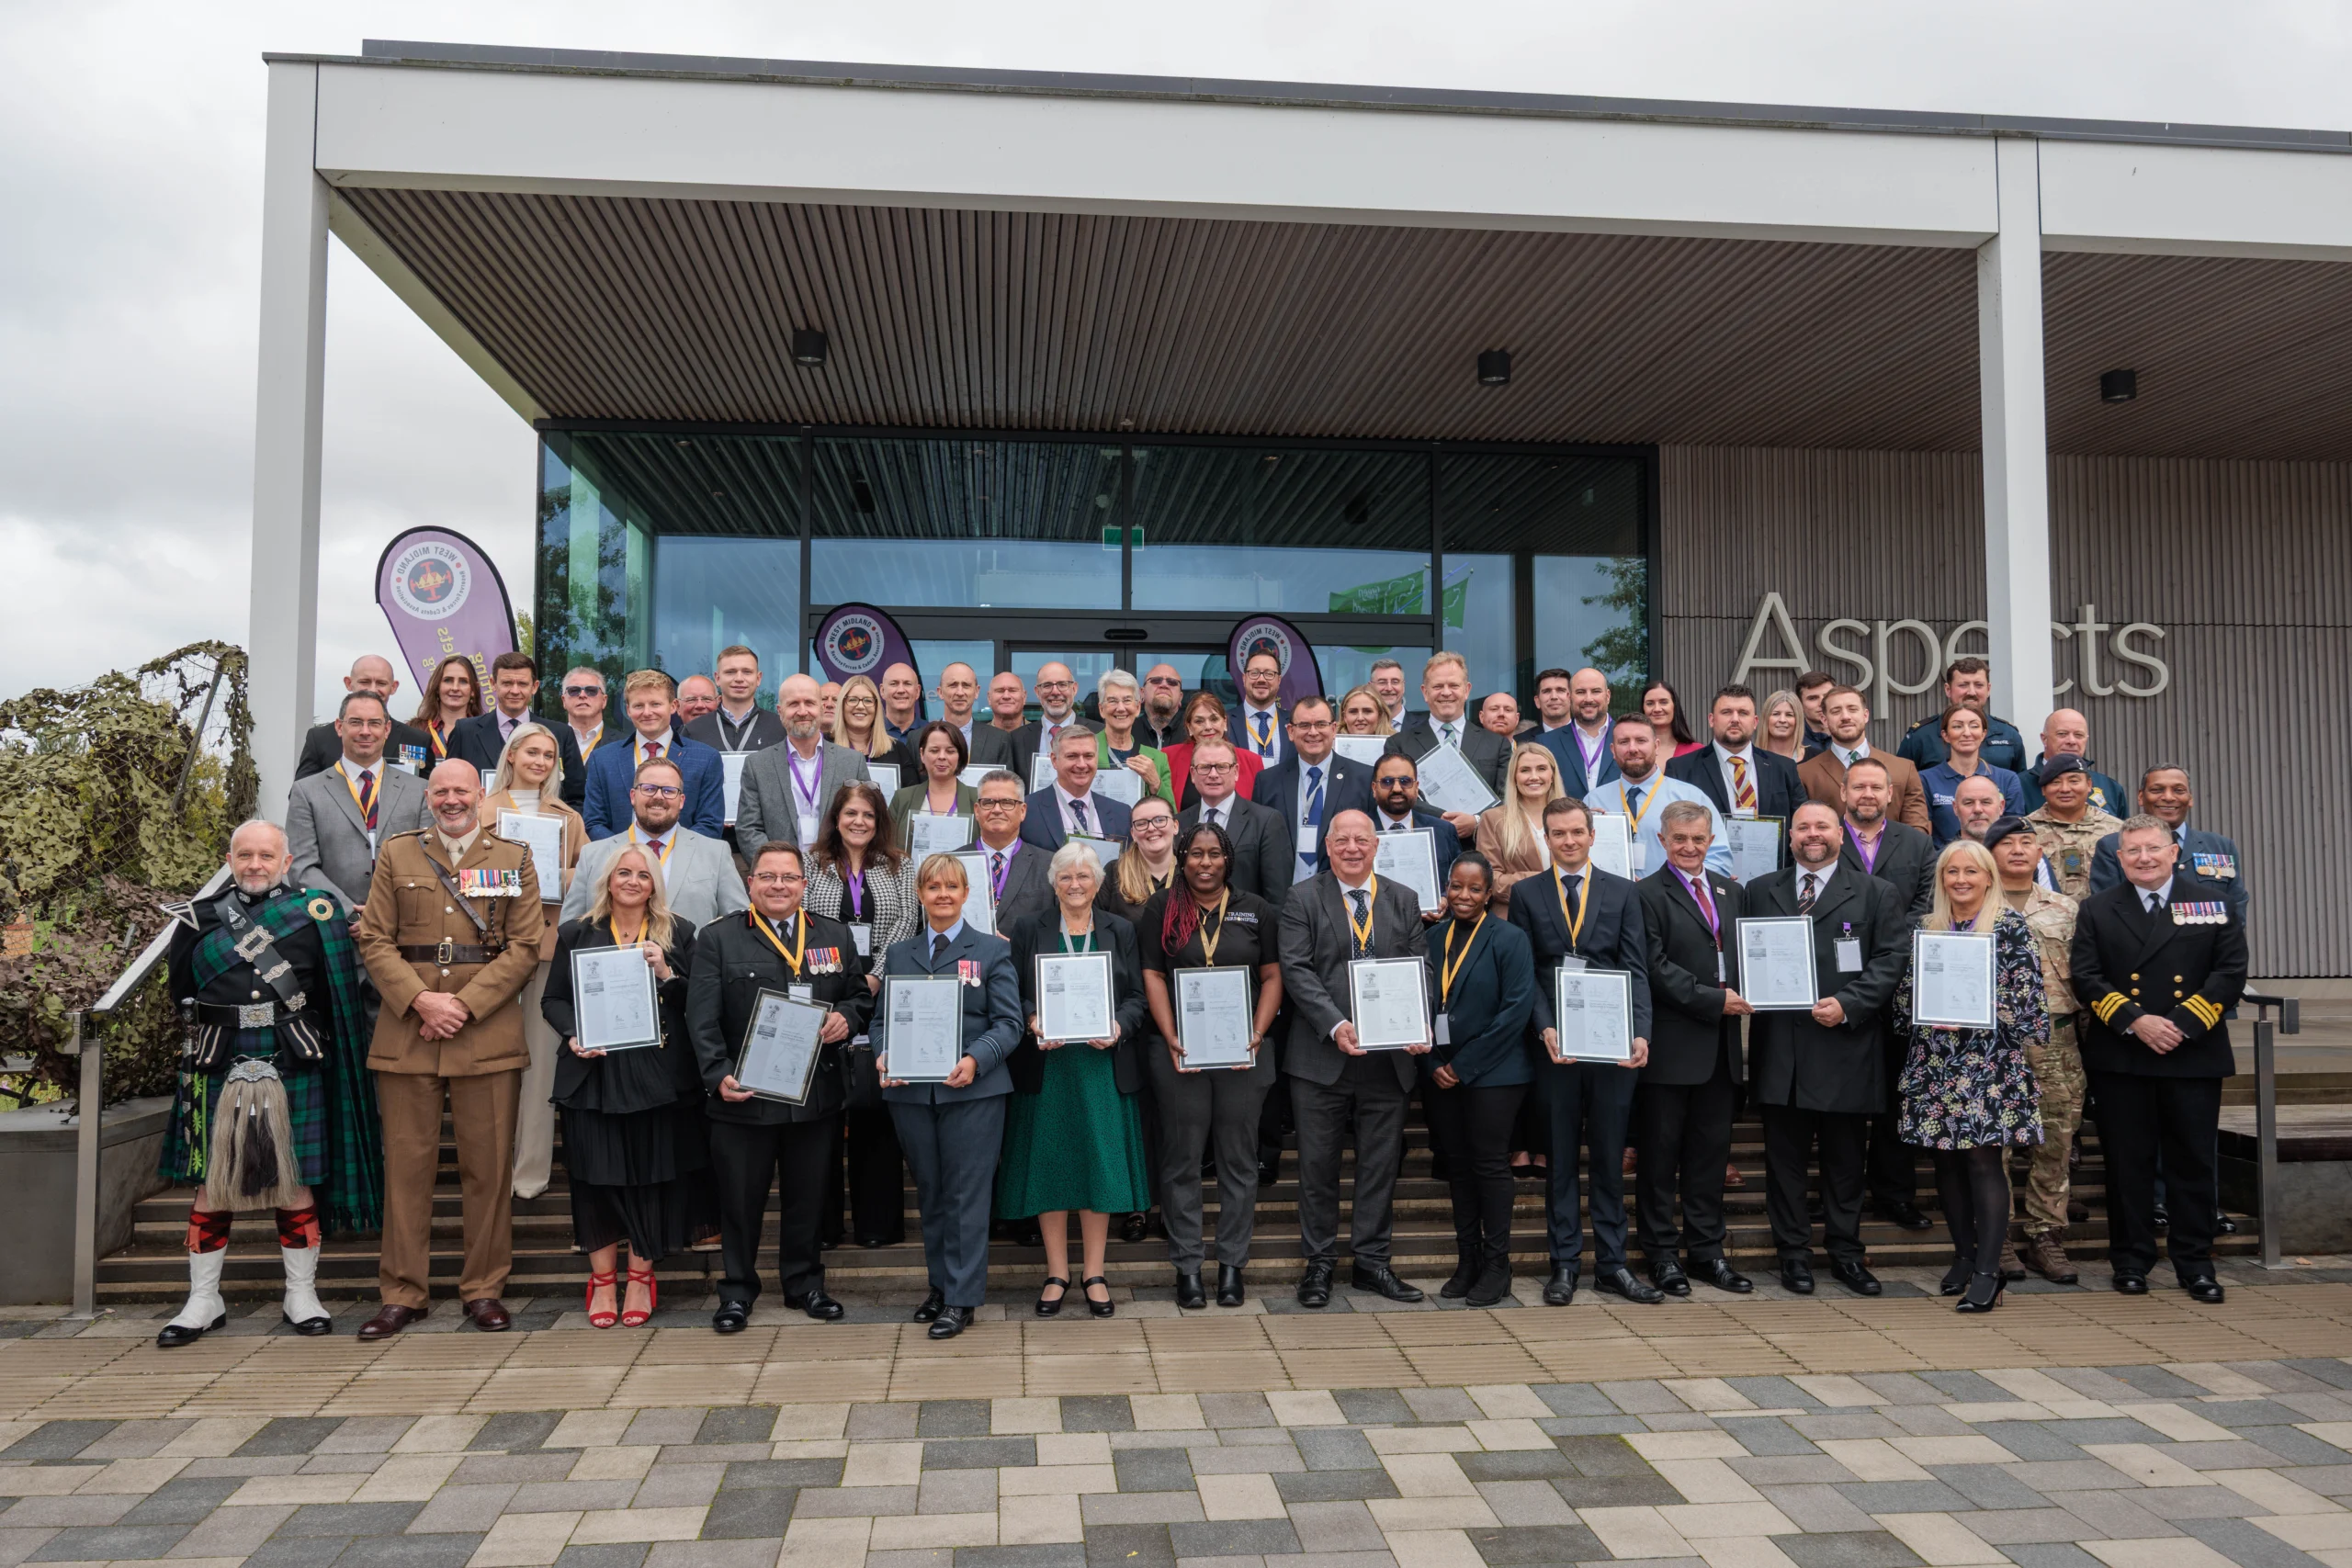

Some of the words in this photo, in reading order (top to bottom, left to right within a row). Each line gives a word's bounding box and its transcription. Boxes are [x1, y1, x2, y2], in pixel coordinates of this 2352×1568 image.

[829, 625, 842, 642] WEST
[842, 617, 872, 627] MIDLAND
[1730, 592, 2170, 720] Aspets
